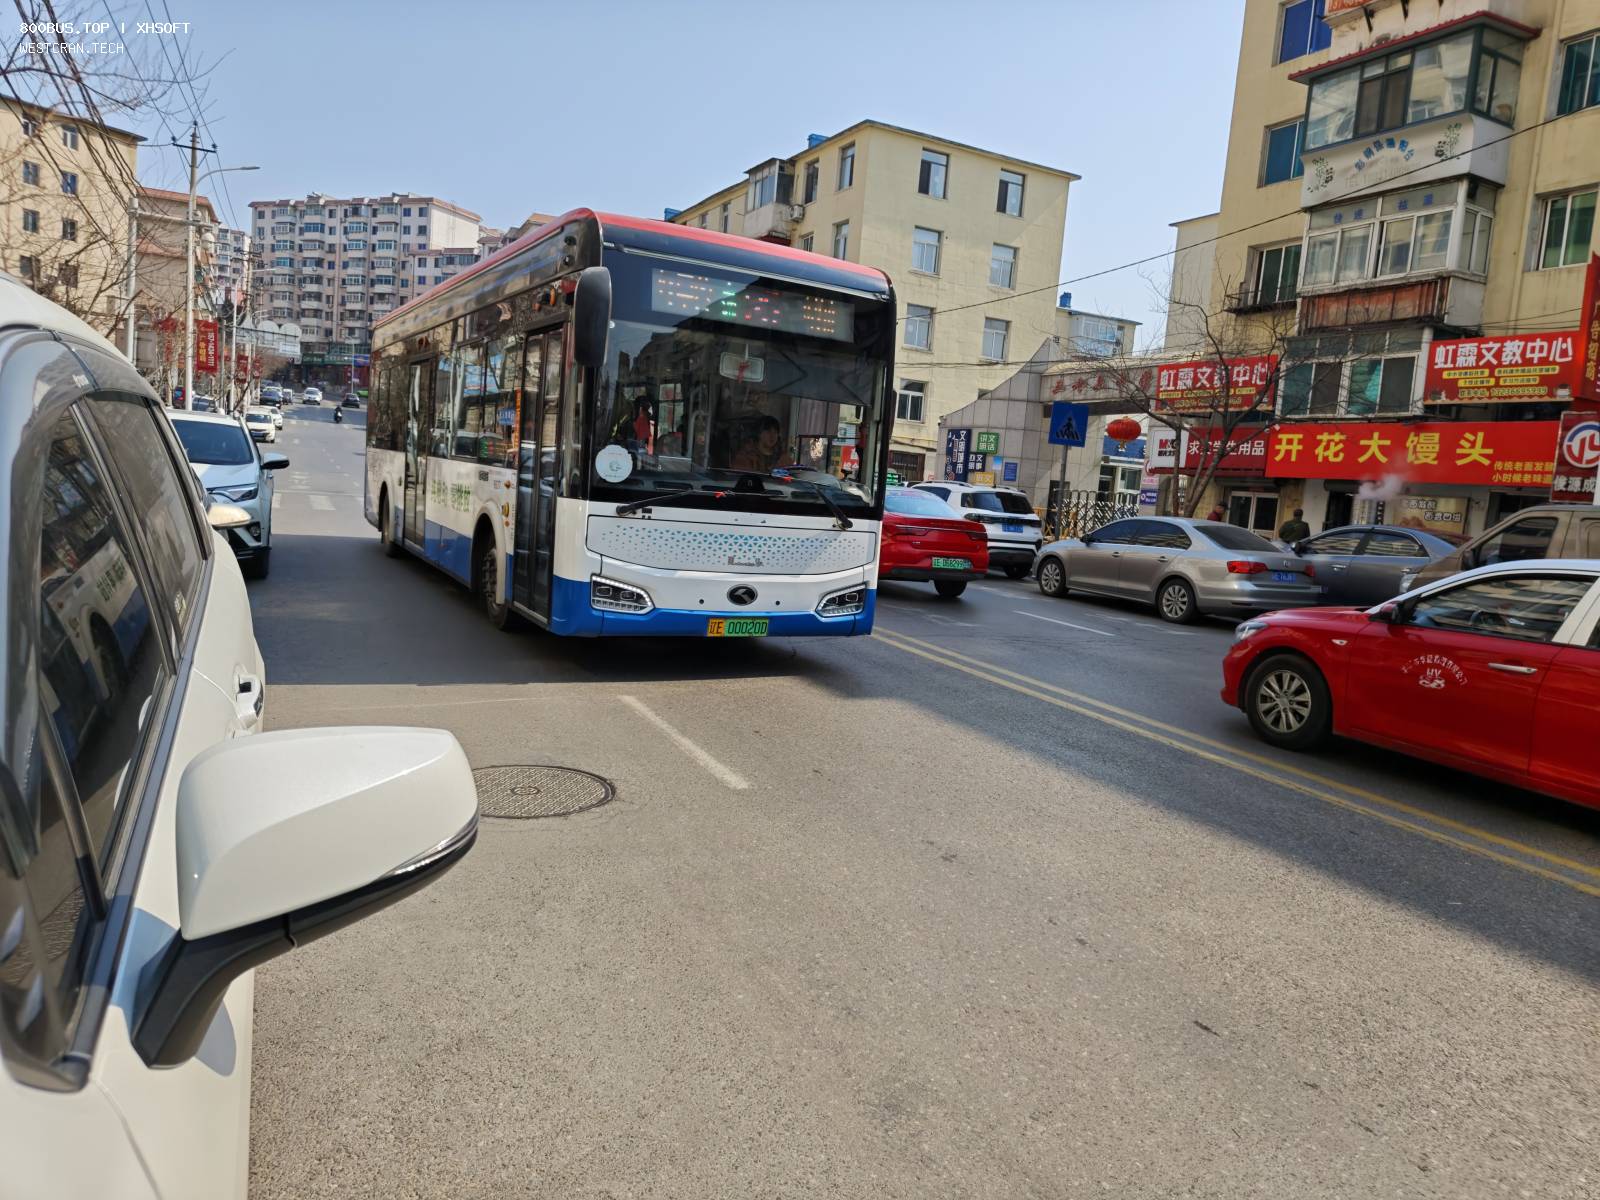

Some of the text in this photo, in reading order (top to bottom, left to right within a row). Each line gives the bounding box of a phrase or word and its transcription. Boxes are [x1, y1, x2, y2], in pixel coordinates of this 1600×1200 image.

[1274, 431, 1494, 466] 开花大馒头
